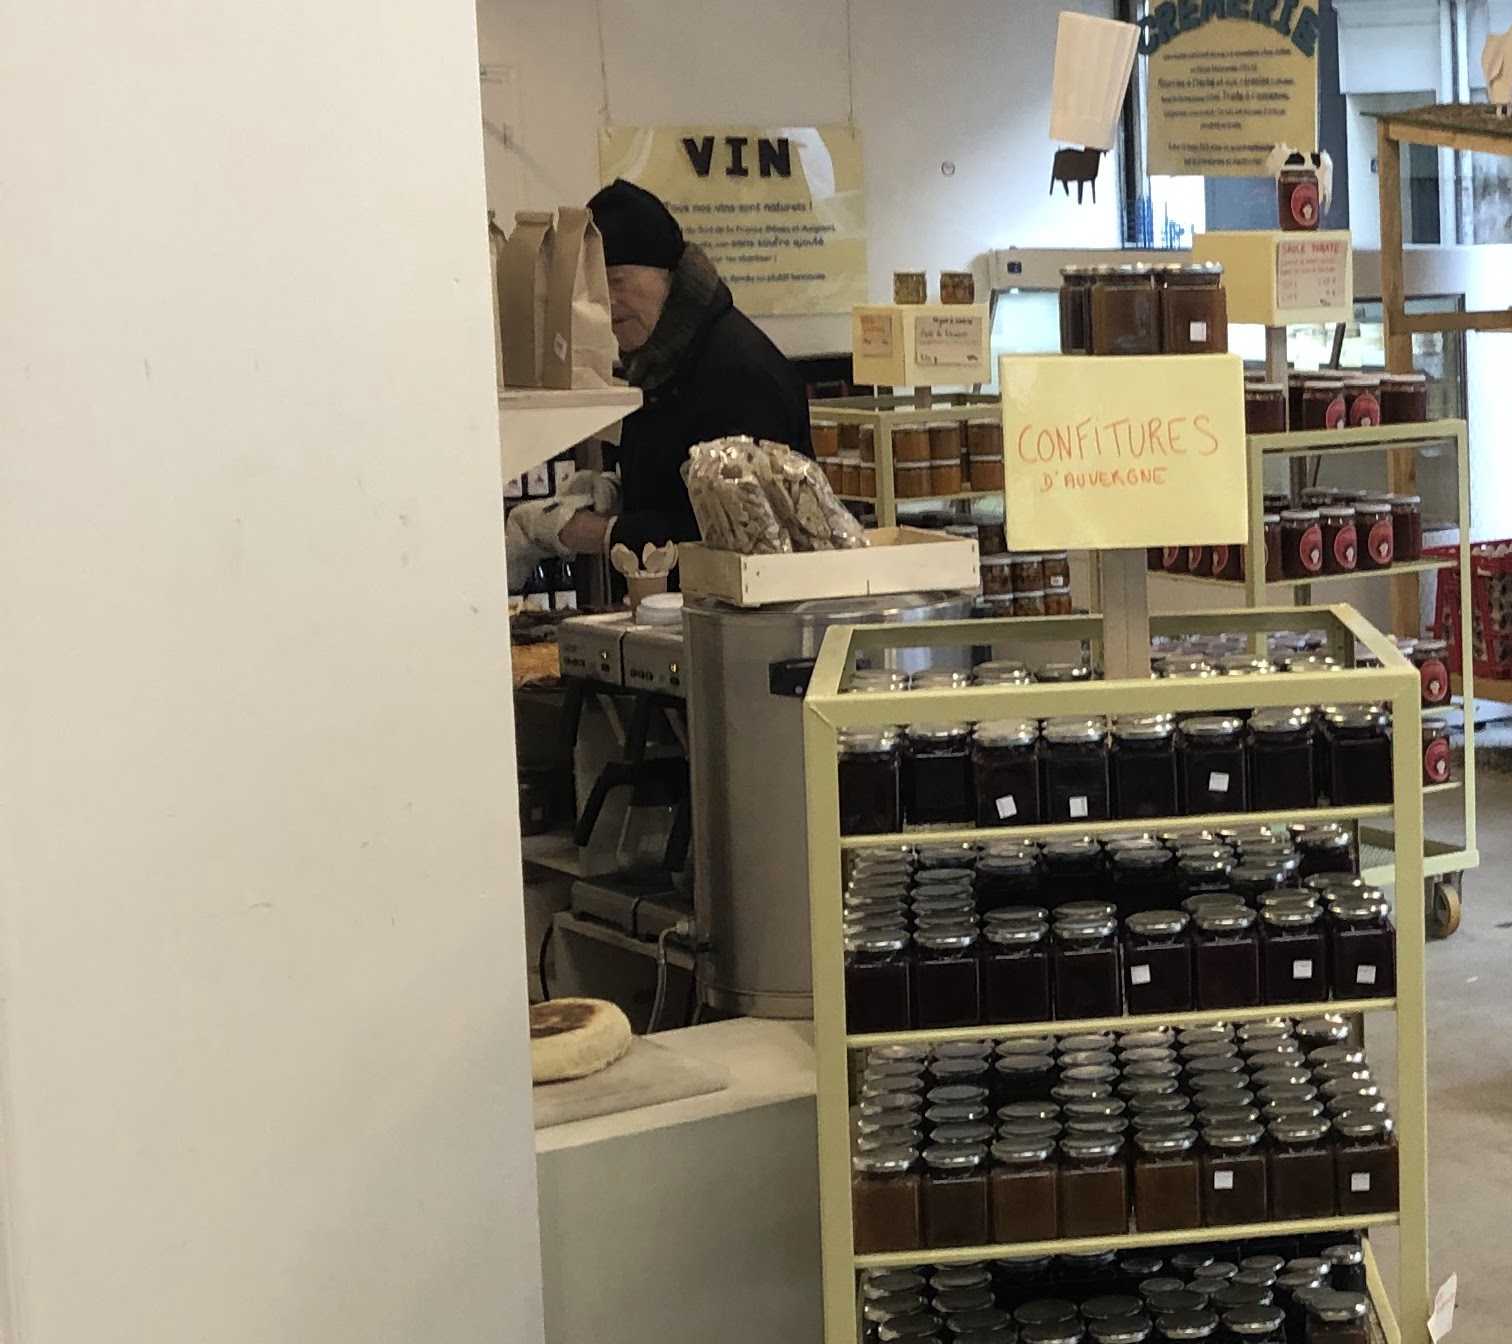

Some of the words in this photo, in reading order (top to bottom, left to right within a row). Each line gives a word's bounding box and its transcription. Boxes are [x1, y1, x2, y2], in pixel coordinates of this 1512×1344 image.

[683, 136, 791, 177] VIN
[715, 203, 735, 213] vins
[1018, 414, 1219, 463] CONFITURES
[1040, 466, 1168, 493] D'AUVERGNE
